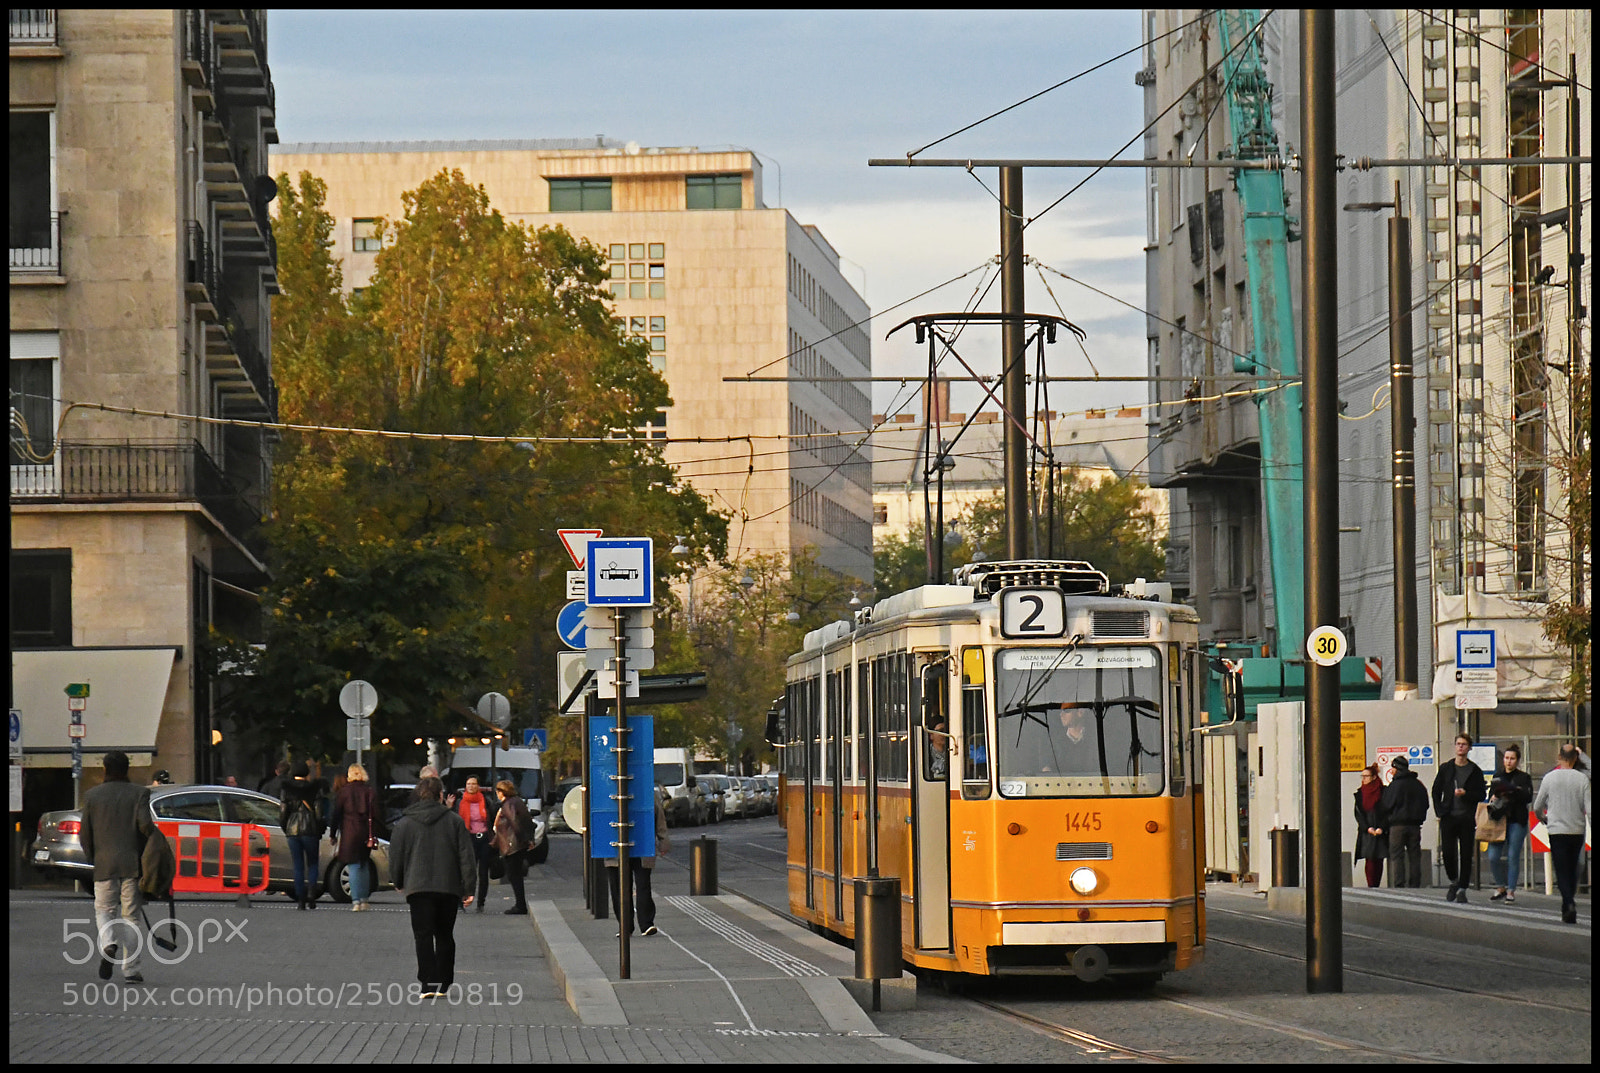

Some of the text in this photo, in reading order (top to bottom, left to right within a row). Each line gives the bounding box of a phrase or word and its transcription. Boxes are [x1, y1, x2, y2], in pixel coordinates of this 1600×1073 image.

[1020, 595, 1045, 631] 2
[1318, 637, 1337, 654] 30
[1074, 654, 1084, 667] 2
[1065, 812, 1102, 832] 1445
